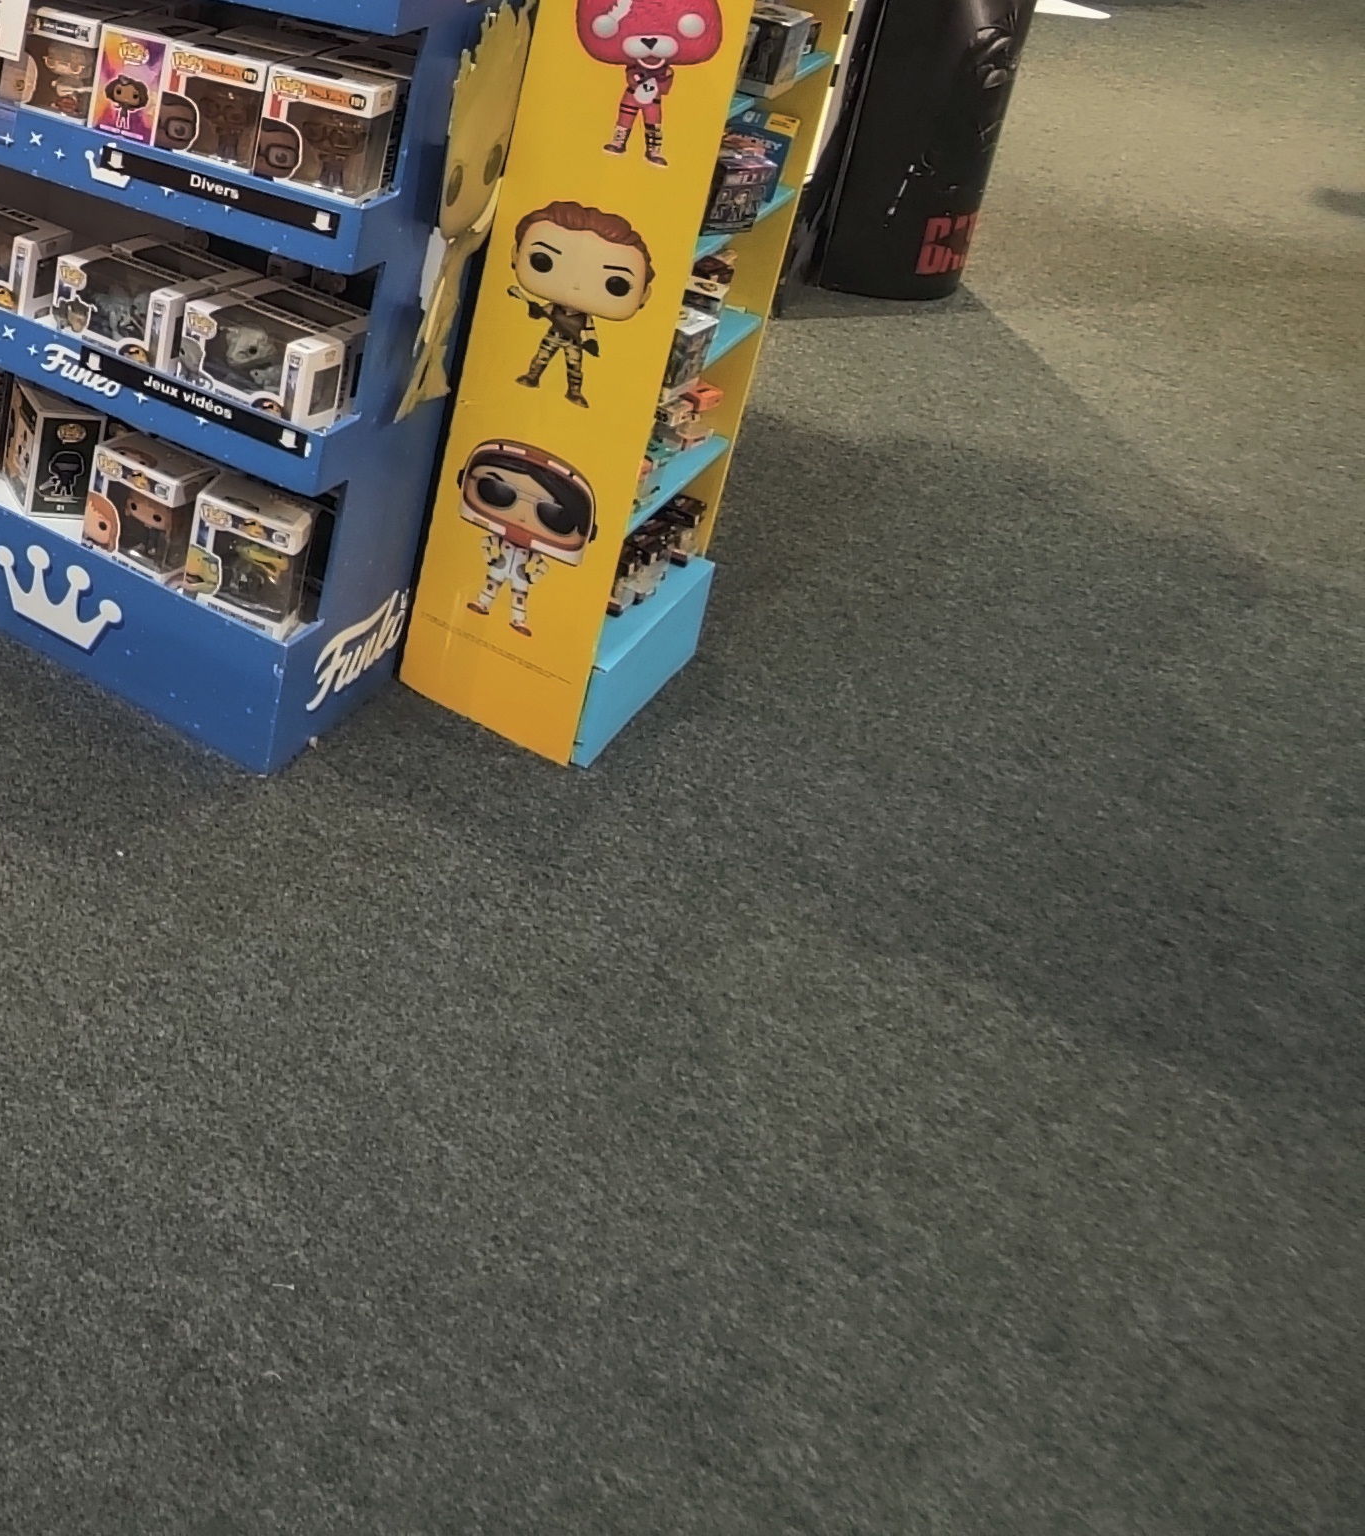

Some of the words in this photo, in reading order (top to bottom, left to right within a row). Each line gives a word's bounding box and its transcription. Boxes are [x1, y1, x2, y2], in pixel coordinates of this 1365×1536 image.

[189, 173, 240, 201] Divers
[143, 375, 179, 396] Jeux
[183, 388, 233, 420] vidéos
[305, 588, 409, 712] Funko
